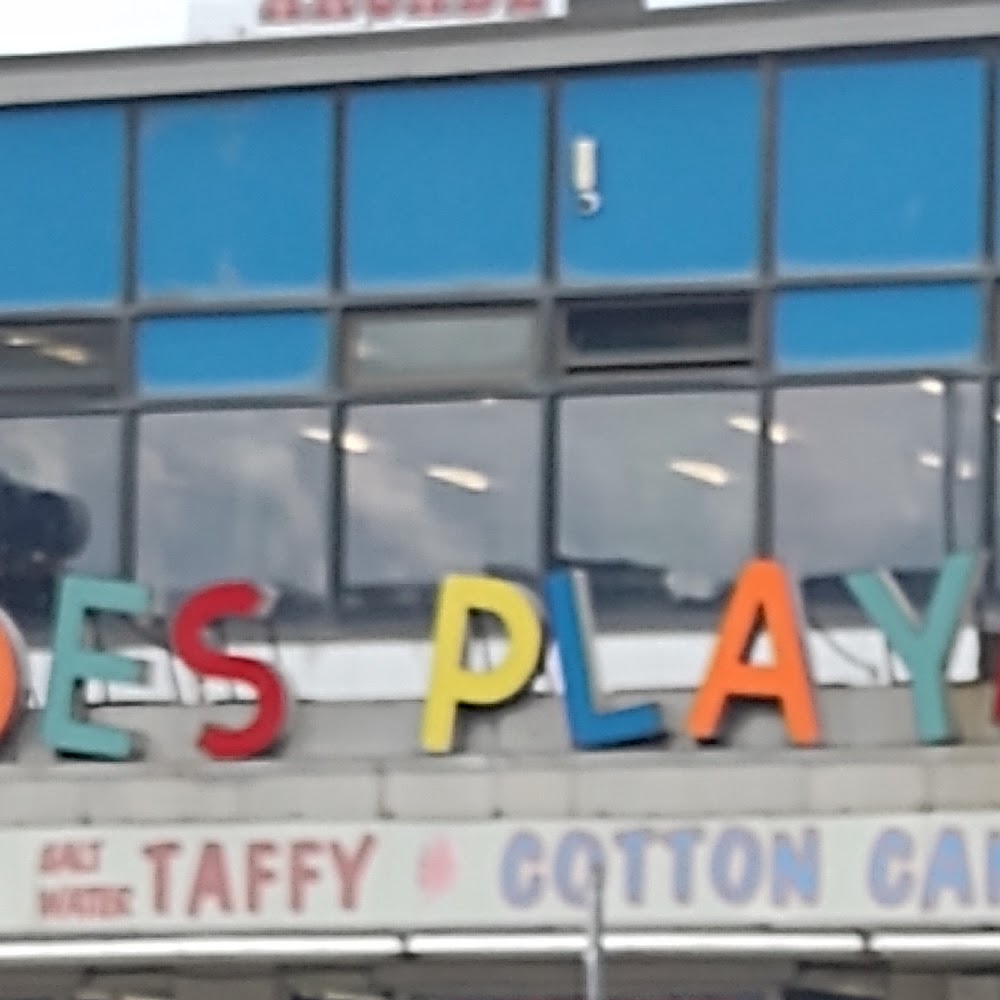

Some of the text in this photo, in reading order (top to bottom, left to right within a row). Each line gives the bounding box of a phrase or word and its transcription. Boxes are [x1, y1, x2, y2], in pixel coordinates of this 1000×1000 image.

[0, 575, 285, 761] ES
[143, 832, 377, 917] TAFFY
[499, 826, 819, 908] COTTON
